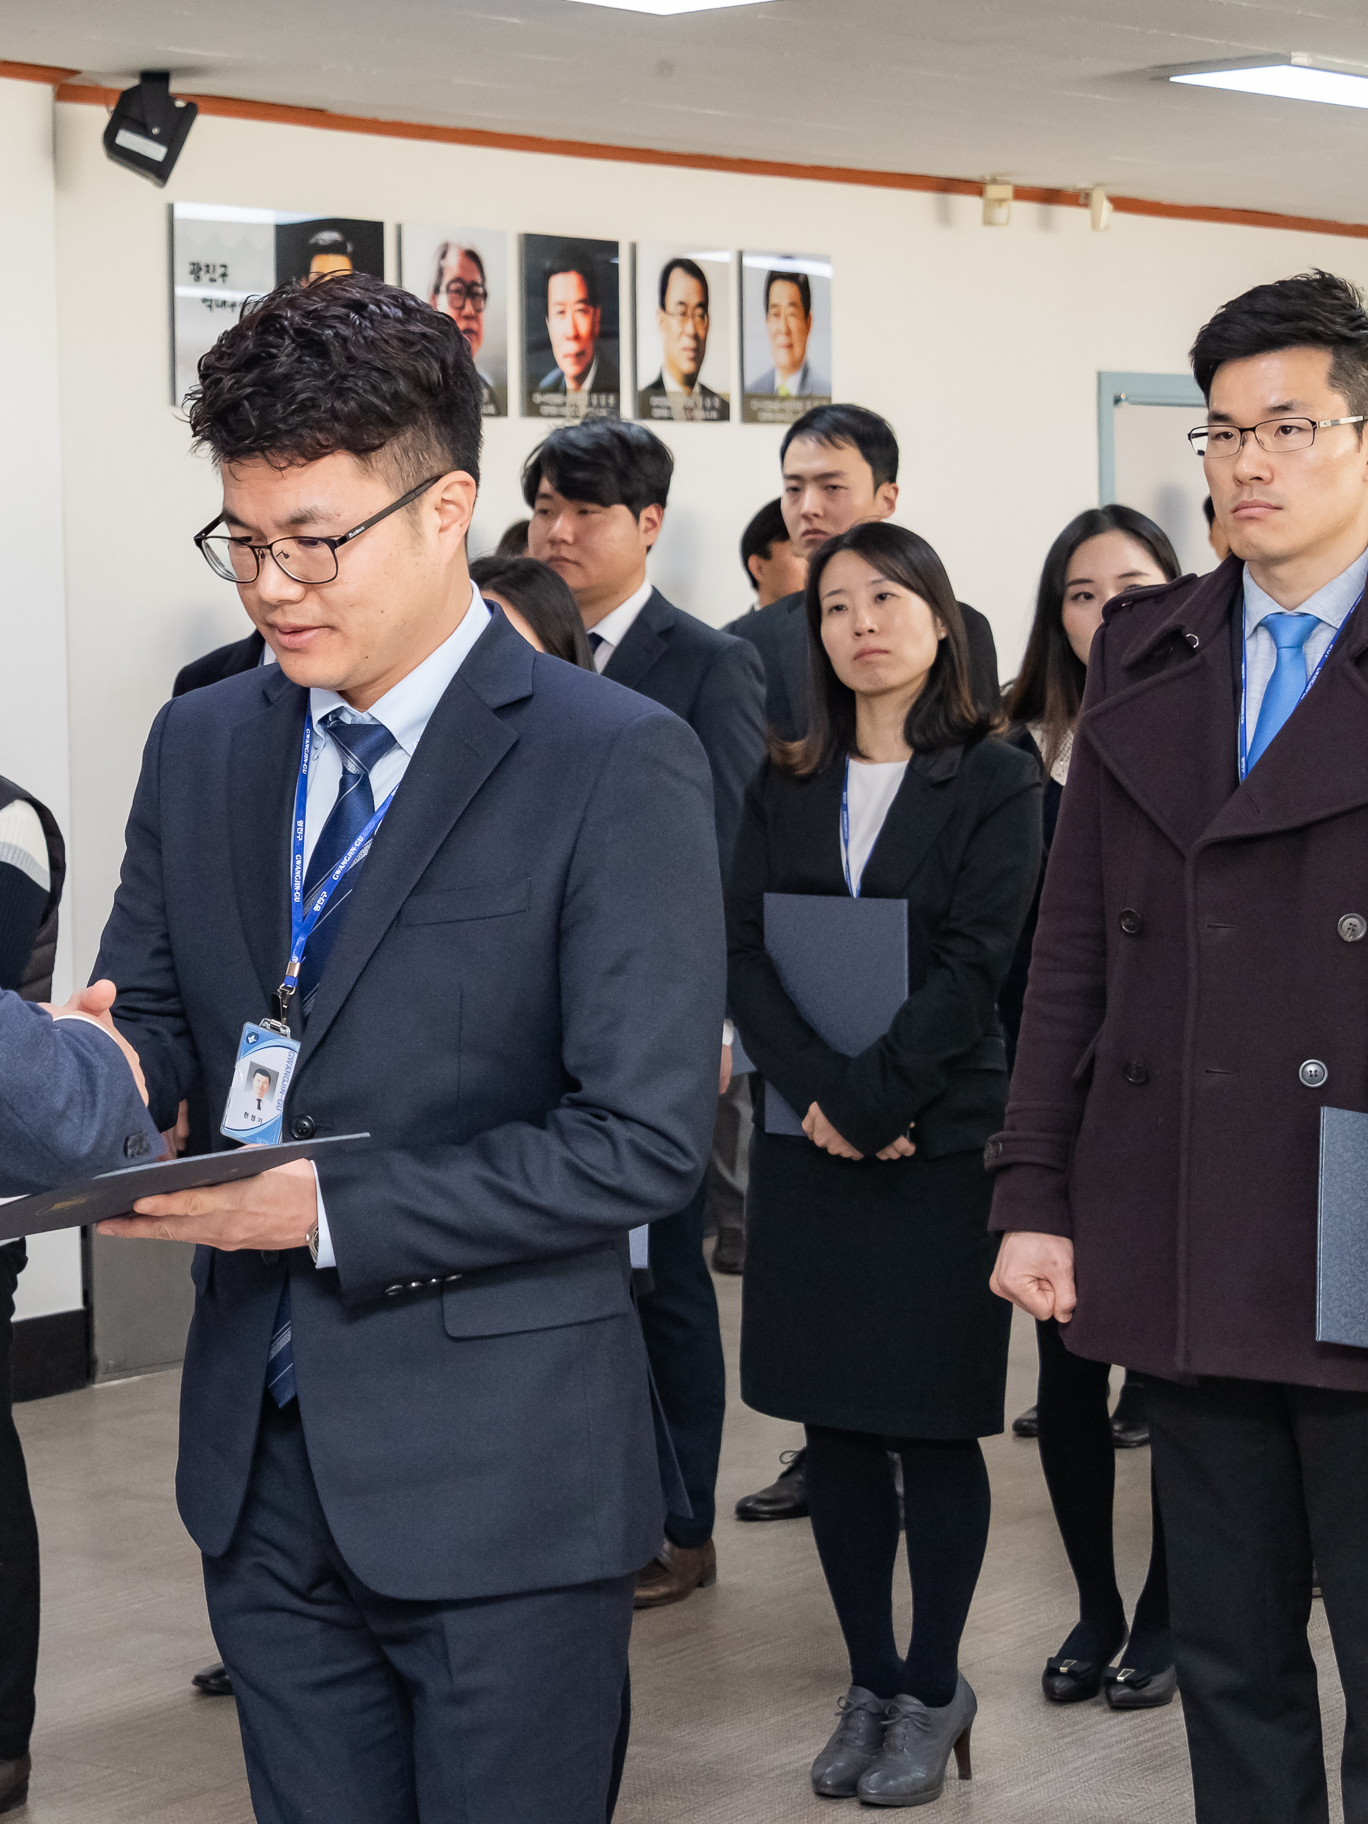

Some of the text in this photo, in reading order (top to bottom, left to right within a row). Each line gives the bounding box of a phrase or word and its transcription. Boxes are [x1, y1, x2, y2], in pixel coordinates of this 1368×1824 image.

[189, 262, 229, 284] 광진구
[293, 854, 302, 903] GWANGJIN-GU
[312, 835, 364, 912] 광진구 GWANGJIN-GU
[275, 1050, 295, 1113] GWANGJIN-GU
